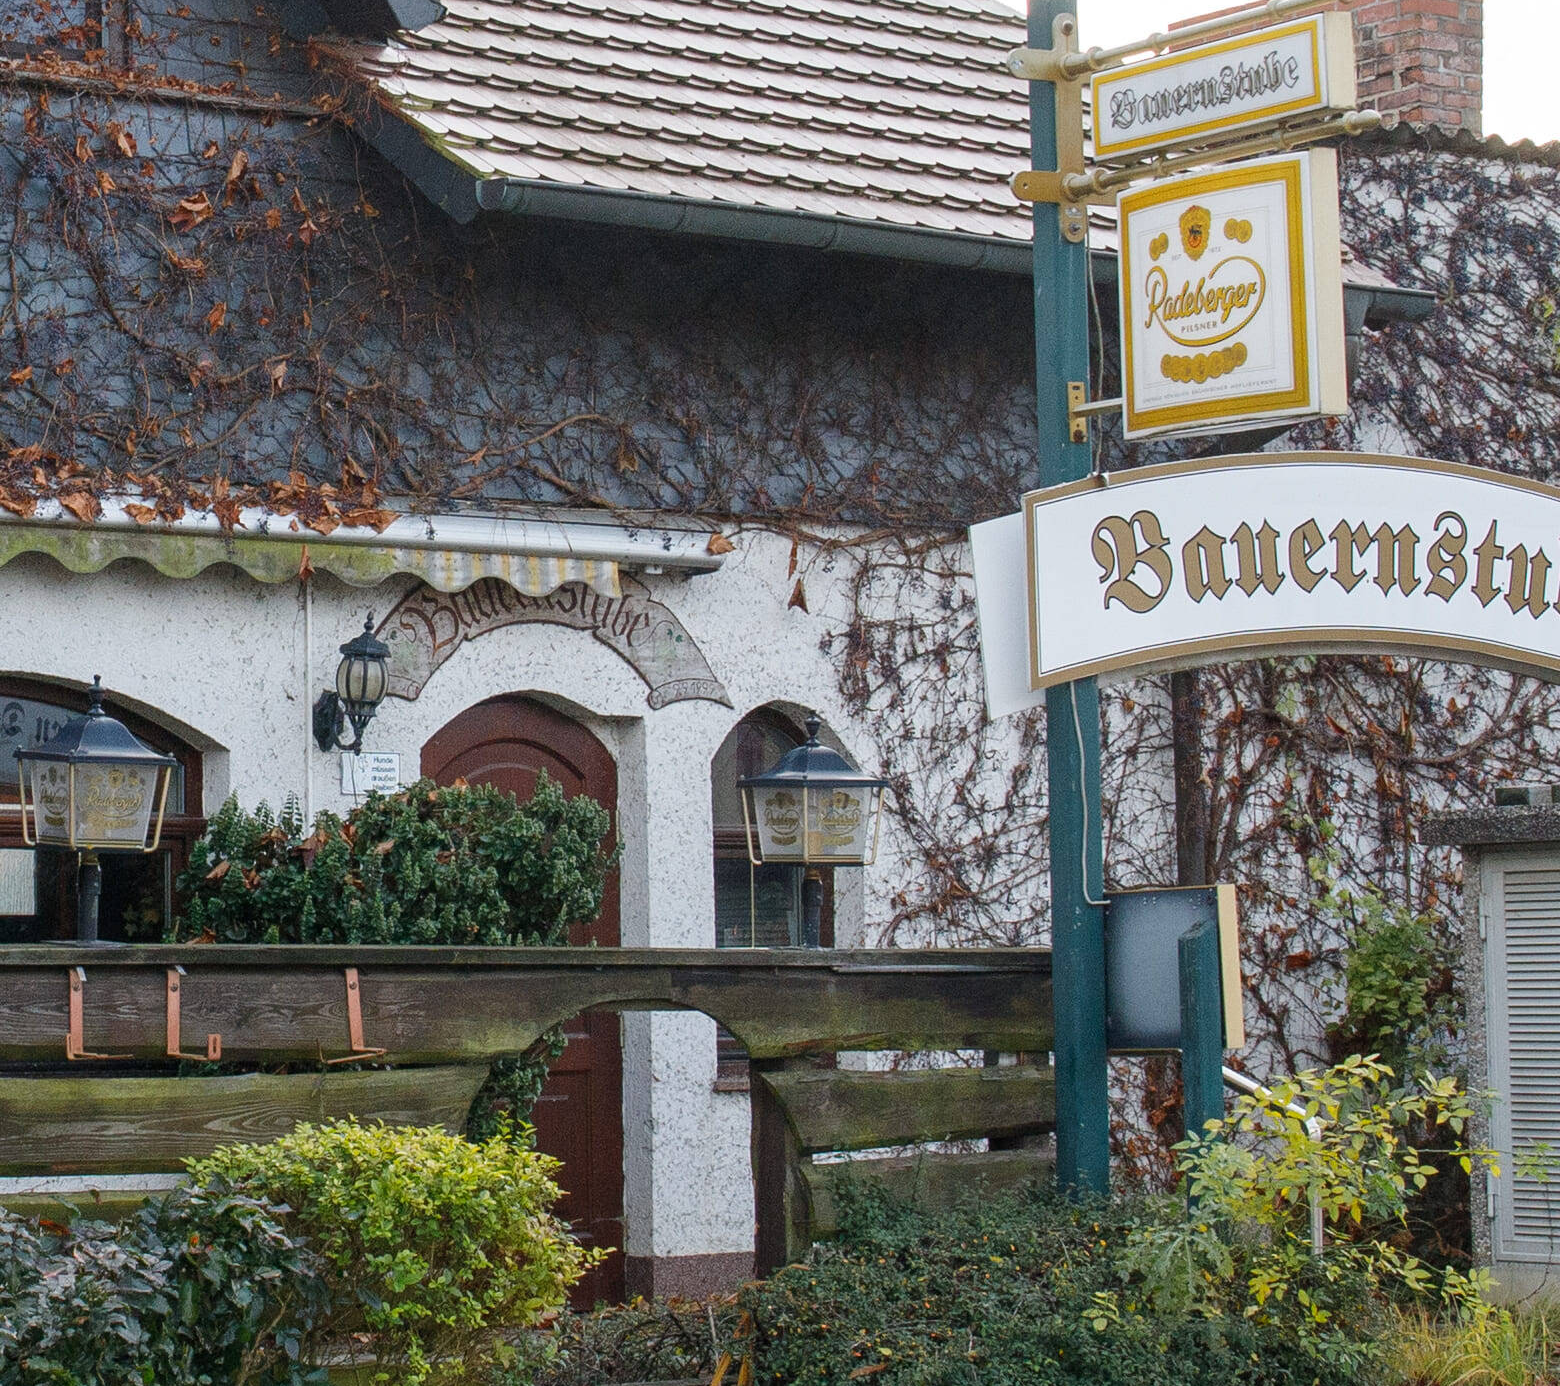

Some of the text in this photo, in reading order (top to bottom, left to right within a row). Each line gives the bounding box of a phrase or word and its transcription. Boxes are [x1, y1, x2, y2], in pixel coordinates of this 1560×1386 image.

[1109, 50, 1300, 130] Bauernstube
[1144, 265, 1258, 329] Radeberger
[1180, 320, 1219, 334] PILSNER
